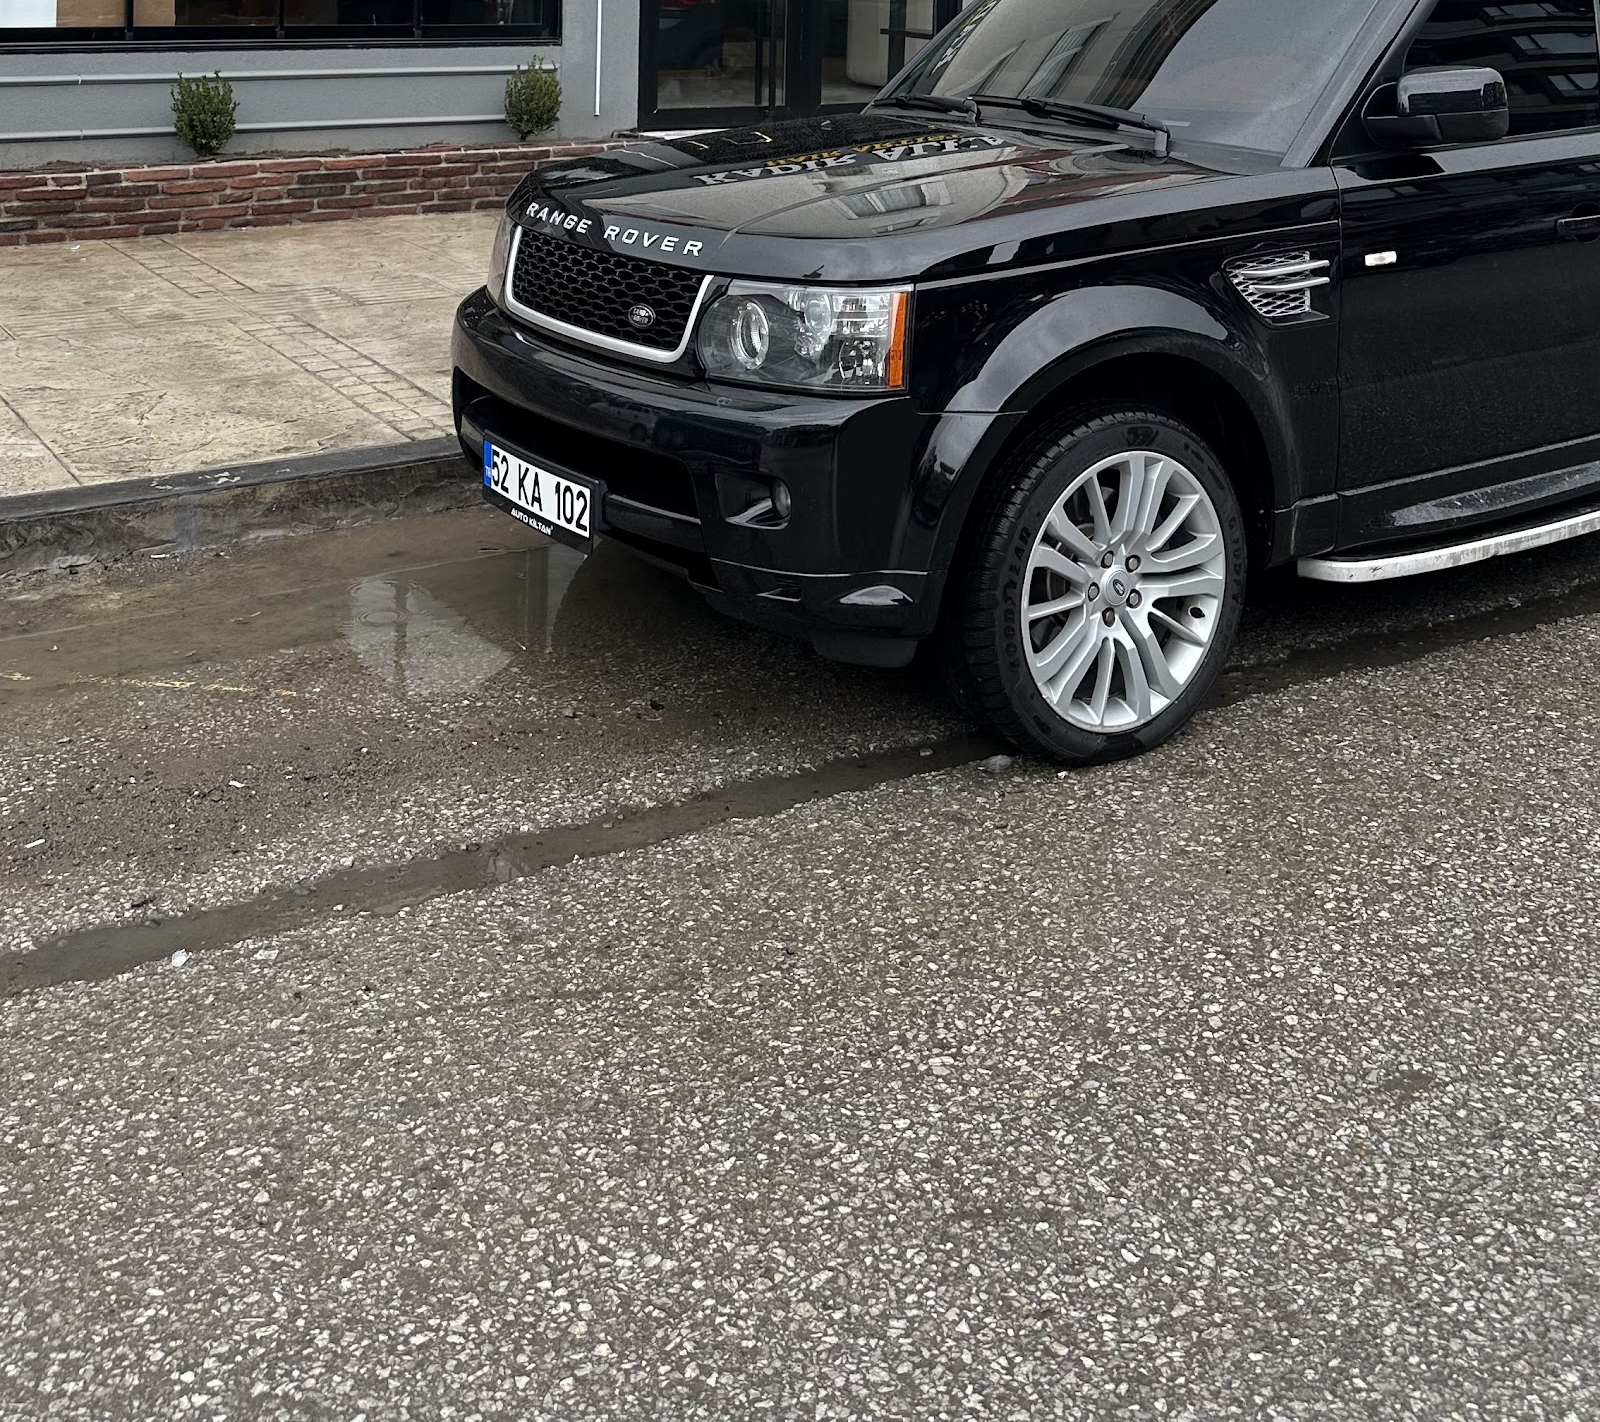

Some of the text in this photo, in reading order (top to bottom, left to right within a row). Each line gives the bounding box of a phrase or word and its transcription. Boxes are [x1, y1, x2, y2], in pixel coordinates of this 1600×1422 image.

[525, 201, 704, 257] RANGE ROVER
[491, 448, 589, 533] 52 KA 102
[510, 507, 529, 524] AUTO
